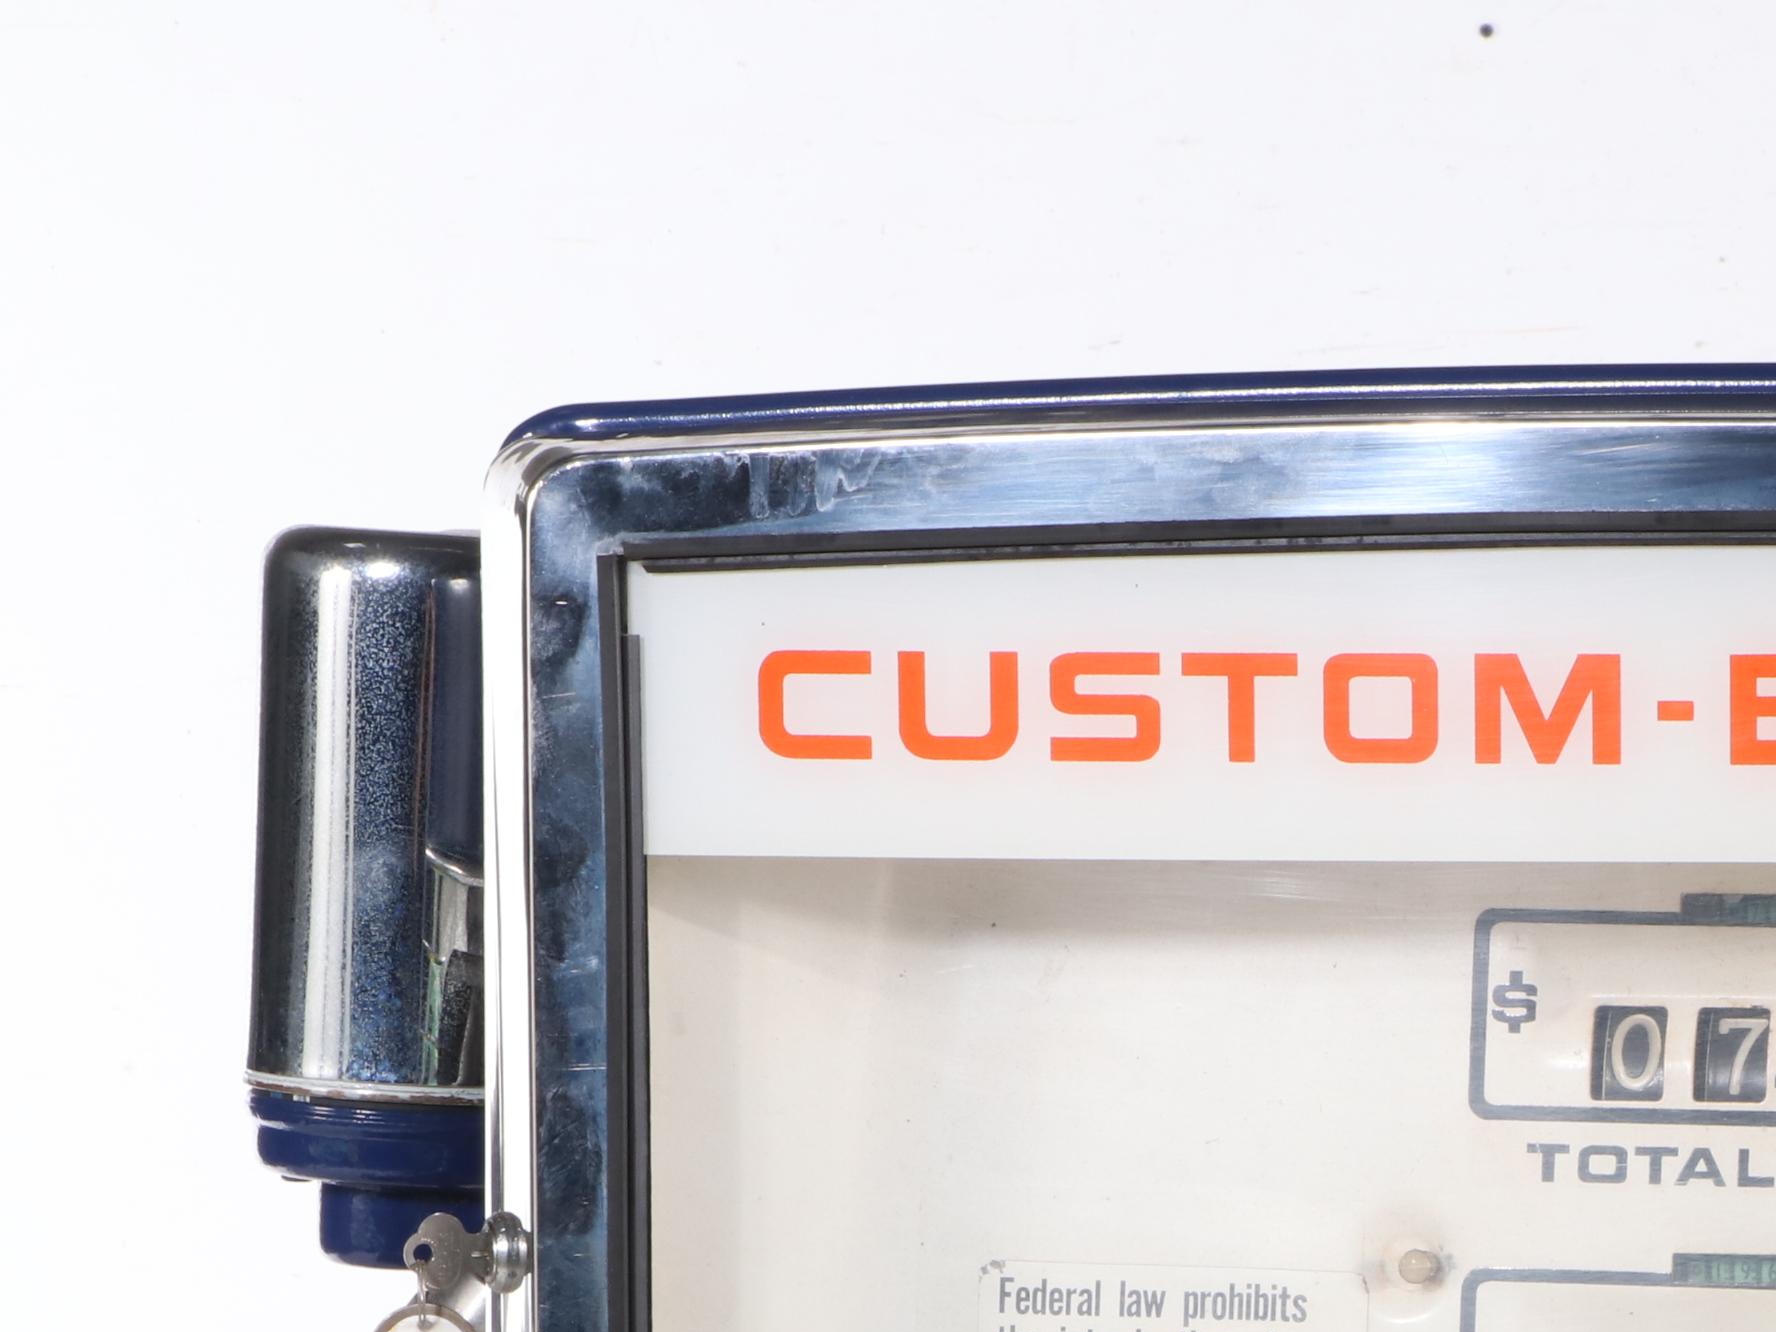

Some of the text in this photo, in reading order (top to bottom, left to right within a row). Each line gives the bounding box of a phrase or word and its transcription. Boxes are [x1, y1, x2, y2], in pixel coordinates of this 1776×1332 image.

[1492, 971, 1537, 1033] $
[1527, 1142, 1775, 1189] TOTAL
[998, 1277, 1308, 1328] Federal law prohibits
